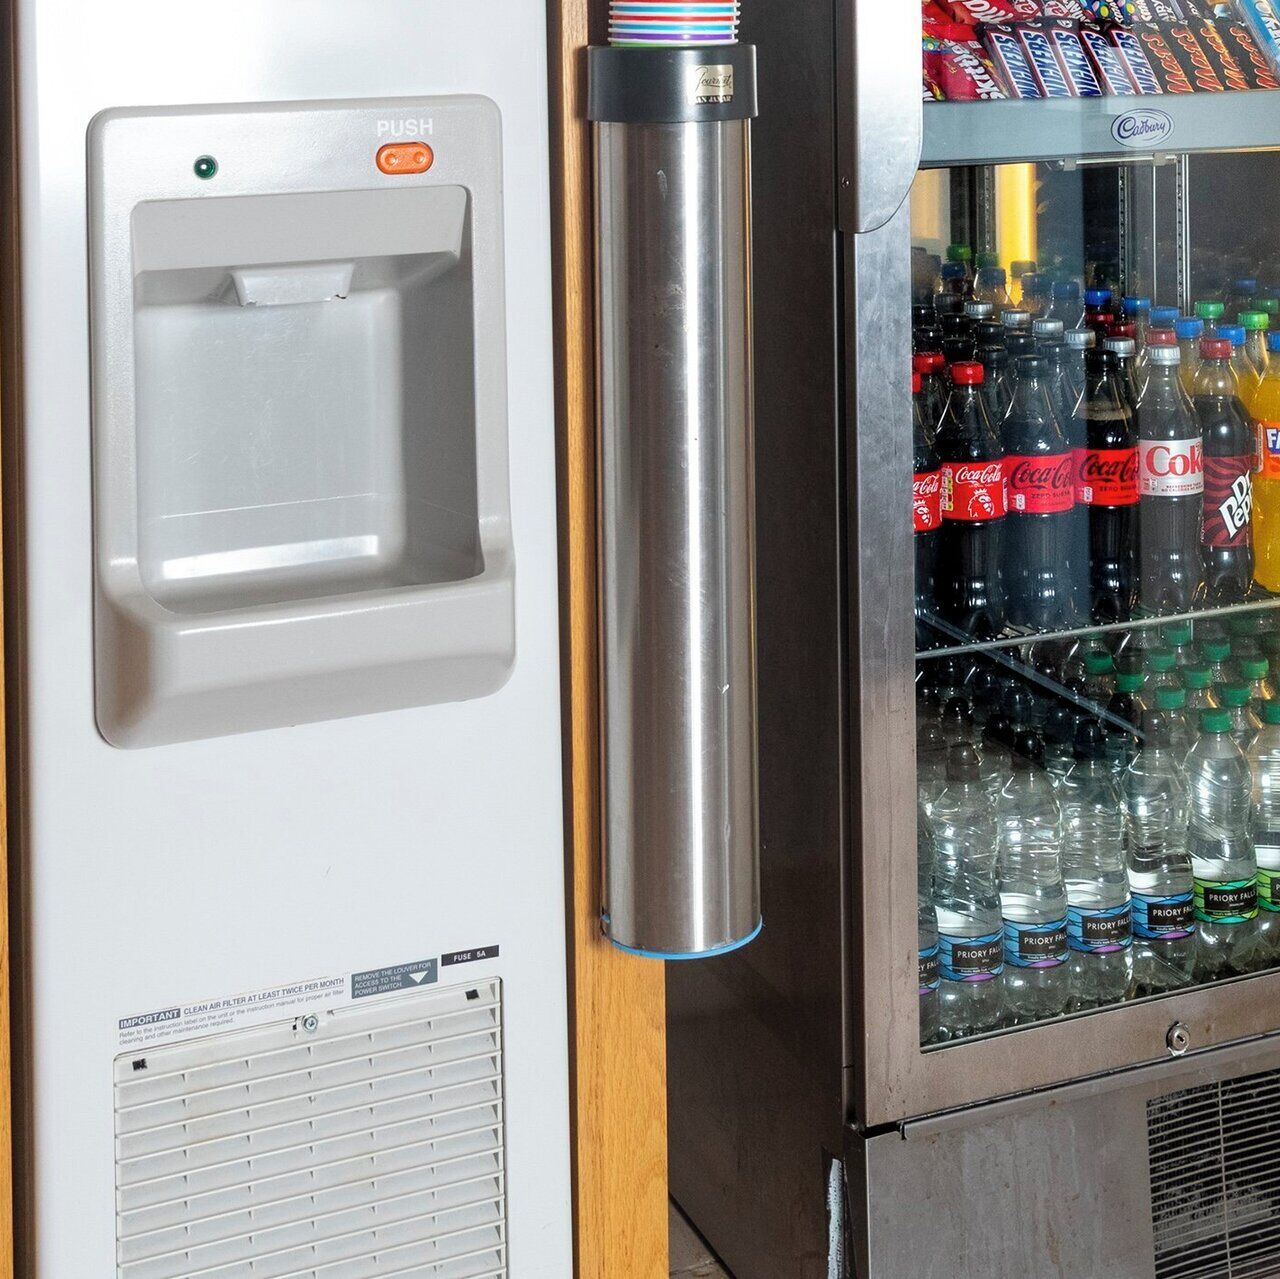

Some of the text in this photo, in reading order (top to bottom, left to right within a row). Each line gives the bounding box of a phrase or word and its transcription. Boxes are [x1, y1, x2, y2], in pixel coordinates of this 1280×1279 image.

[1141, 32, 1195, 93] Mars
[1171, 28, 1224, 91] Mars
[1200, 27, 1250, 90] Mars
[1230, 26, 1280, 89] Mars
[378, 118, 433, 137] PUSH
[1117, 116, 1166, 139] Cadbury
[955, 463, 1003, 485] Coca-Cola
[1209, 893, 1238, 902] PRIORY
[1152, 908, 1181, 917] PRIORY
[1087, 921, 1116, 931] PRIORY
[1024, 935, 1054, 945] PRIORY
[453, 950, 487, 962] FUSE 5A
[957, 951, 987, 959] PRIORY
[354, 973, 380, 982] REMOVE
[394, 964, 418, 974] LOUVER
[419, 961, 432, 970] FOR
[354, 980, 380, 989] ACCESS
[390, 975, 402, 983] THE
[354, 982, 402, 996] POWER SWITCH
[184, 977, 344, 1015] CLEAN AIR FILTER AT LEAST TWICE PER MONTH
[120, 1009, 179, 1029] IMPORTANT
[154, 1022, 183, 1032] instruction
[184, 1018, 199, 1026] label
[207, 1013, 216, 1021] the
[218, 1011, 229, 1019] unit
[247, 1003, 275, 1014] instruction
[276, 999, 296, 1008] manual
[305, 994, 323, 1003] proper
[332, 988, 344, 996] filter
[120, 1035, 144, 1046] cleaning
[145, 1033, 156, 1041] and
[157, 1029, 172, 1038] other
[173, 1023, 209, 1035] maintenance
